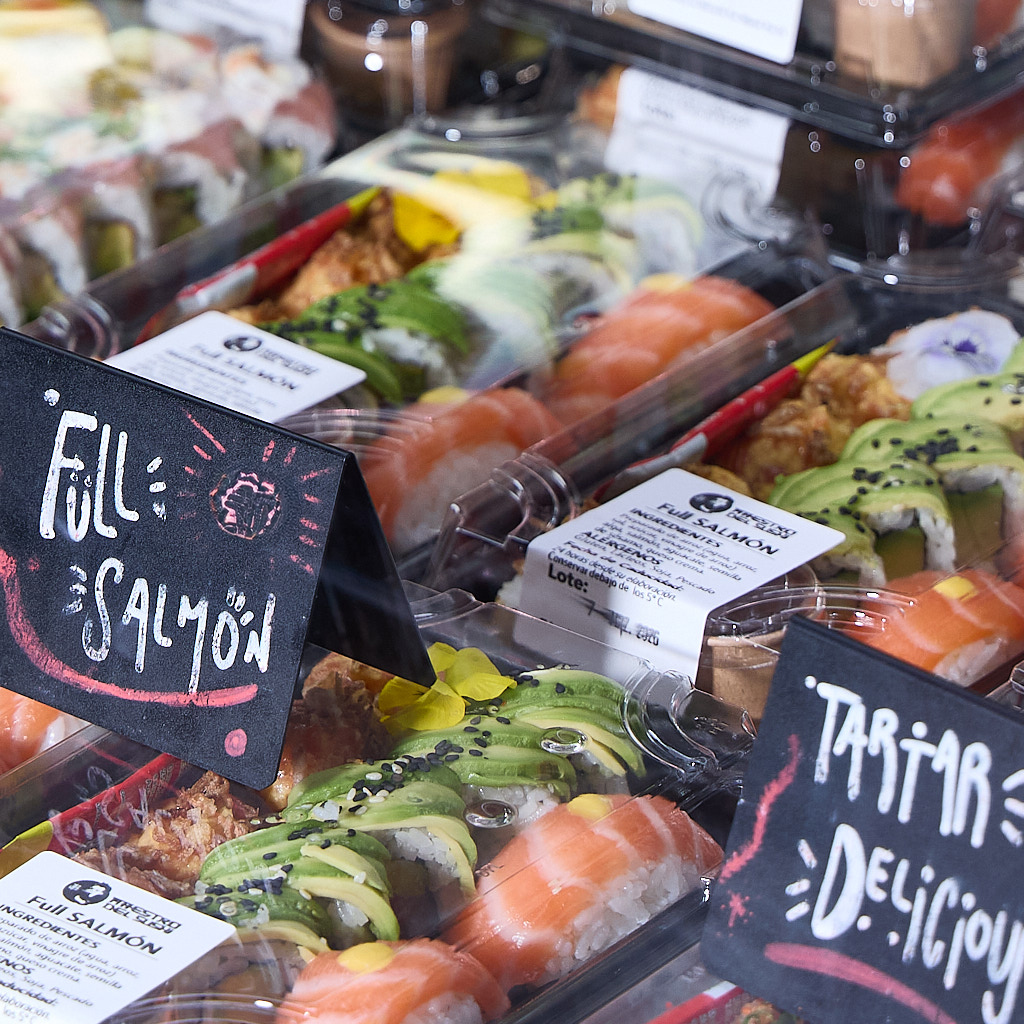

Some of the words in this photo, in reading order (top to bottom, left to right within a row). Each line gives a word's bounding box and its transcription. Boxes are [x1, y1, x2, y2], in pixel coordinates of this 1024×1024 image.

[629, 508, 724, 548] INGREDIENTES
[657, 503, 694, 520] Full
[692, 517, 779, 555] SALMÓN
[548, 551, 589, 576] Conservar
[589, 567, 617, 588] debajo
[618, 581, 629, 592] de
[632, 585, 644, 599] los
[548, 563, 588, 593] Lote:
[676, 576, 716, 594] Pescado
[814, 680, 993, 849] TARTAR
[102, 902, 130, 918] DEL
[27, 895, 68, 916] Full
[66, 912, 163, 955] SALMÓN
[15, 953, 47, 969] queso
[32, 941, 70, 958] vinagre
[70, 955, 85, 965] de
[34, 952, 83, 975] aguacate,
[49, 986, 93, 1008] Pescado
